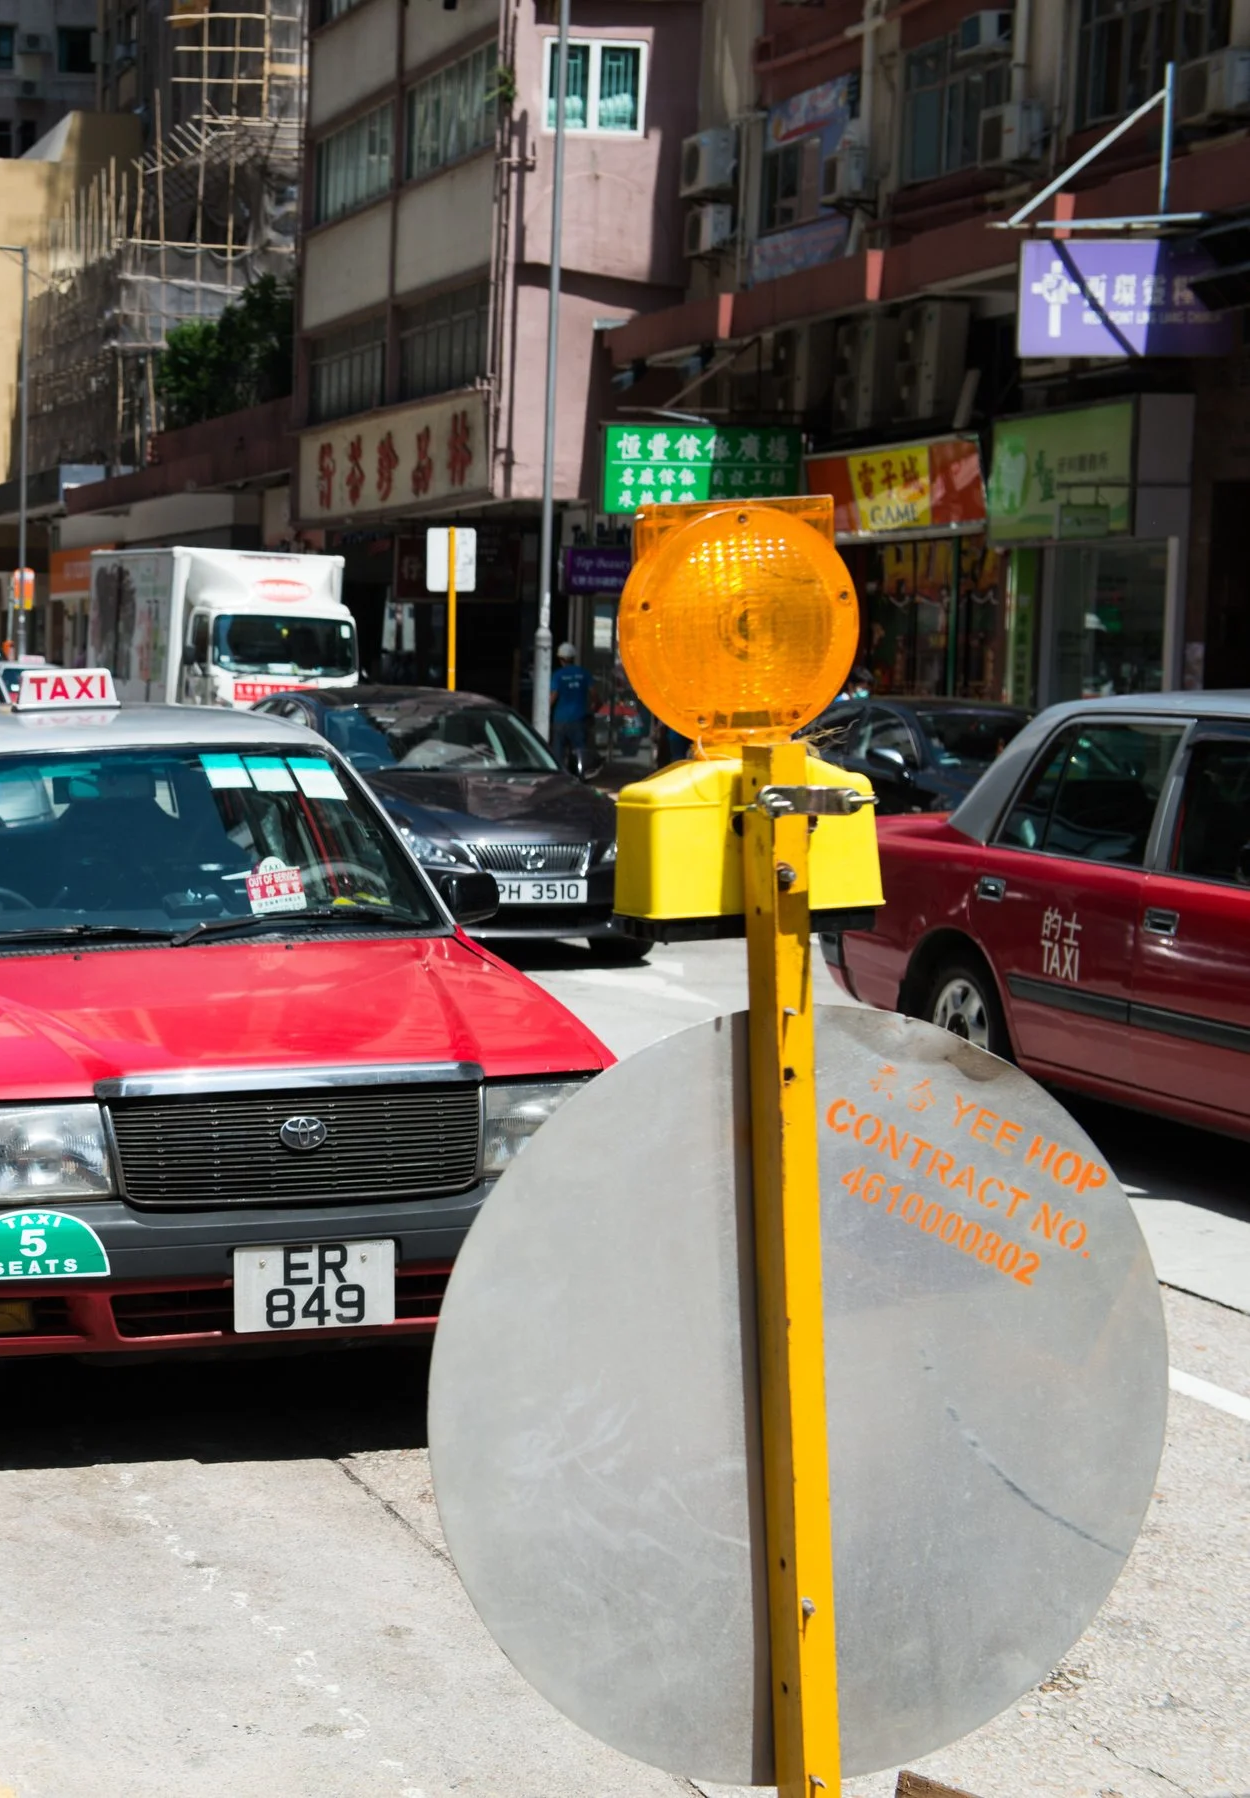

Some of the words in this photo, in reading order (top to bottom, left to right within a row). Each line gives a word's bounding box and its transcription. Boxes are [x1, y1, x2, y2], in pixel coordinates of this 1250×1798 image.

[869, 502, 920, 526] GAME
[29, 675, 106, 701] TAXI
[248, 876, 264, 888] OUT
[263, 873, 274, 886] OF
[264, 863, 282, 873] TAXI
[531, 883, 580, 901] 3510
[1041, 906, 1083, 947] 的士
[1040, 939, 1080, 983] TAXI
[953, 1094, 1024, 1156] YEE
[1024, 1135, 1108, 1194] HOP
[825, 1099, 1031, 1219] CONTRACT
[1030, 1202, 1091, 1260] NO.
[2, 1213, 63, 1231] TAXI
[840, 1165, 1041, 1286] 4610000802
[18, 1228, 48, 1257] 5
[282, 1243, 349, 1287] ER
[265, 1283, 367, 1330] 849
